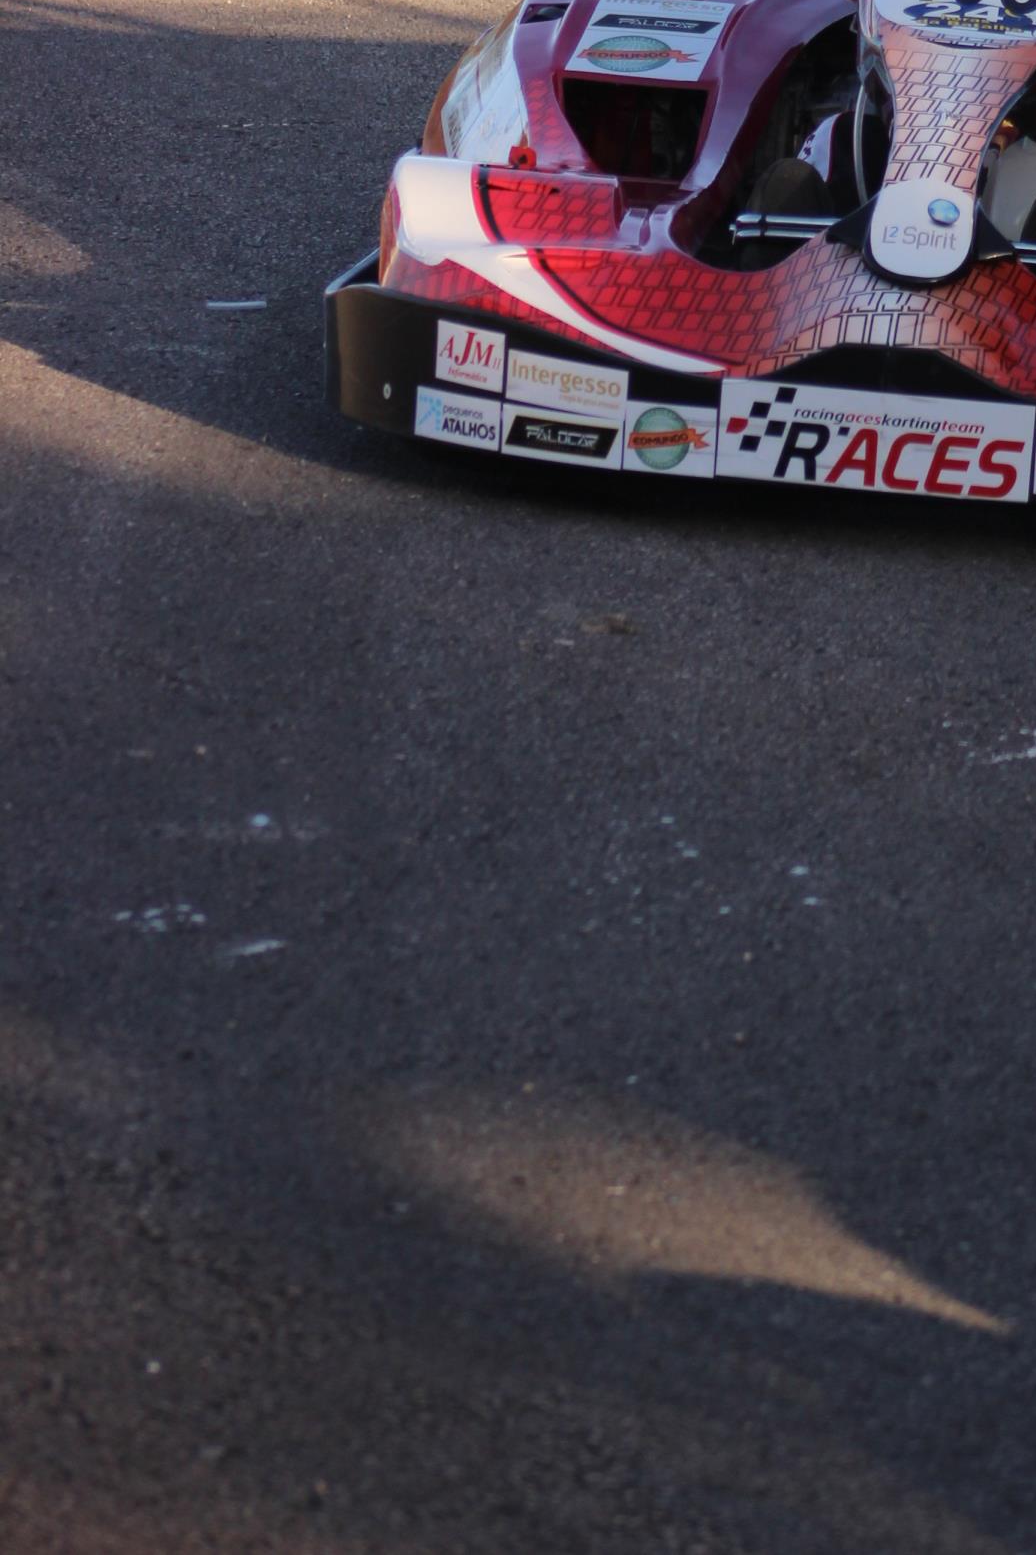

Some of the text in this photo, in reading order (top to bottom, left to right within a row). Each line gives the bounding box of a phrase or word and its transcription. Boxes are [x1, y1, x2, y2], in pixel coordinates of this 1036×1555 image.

[902, 226, 957, 251] Spirit
[438, 331, 495, 368] AJM
[511, 358, 622, 398] Intergesso
[442, 403, 484, 423] pequenos
[441, 417, 496, 442] ATALHOS
[773, 421, 1025, 499] RACES
